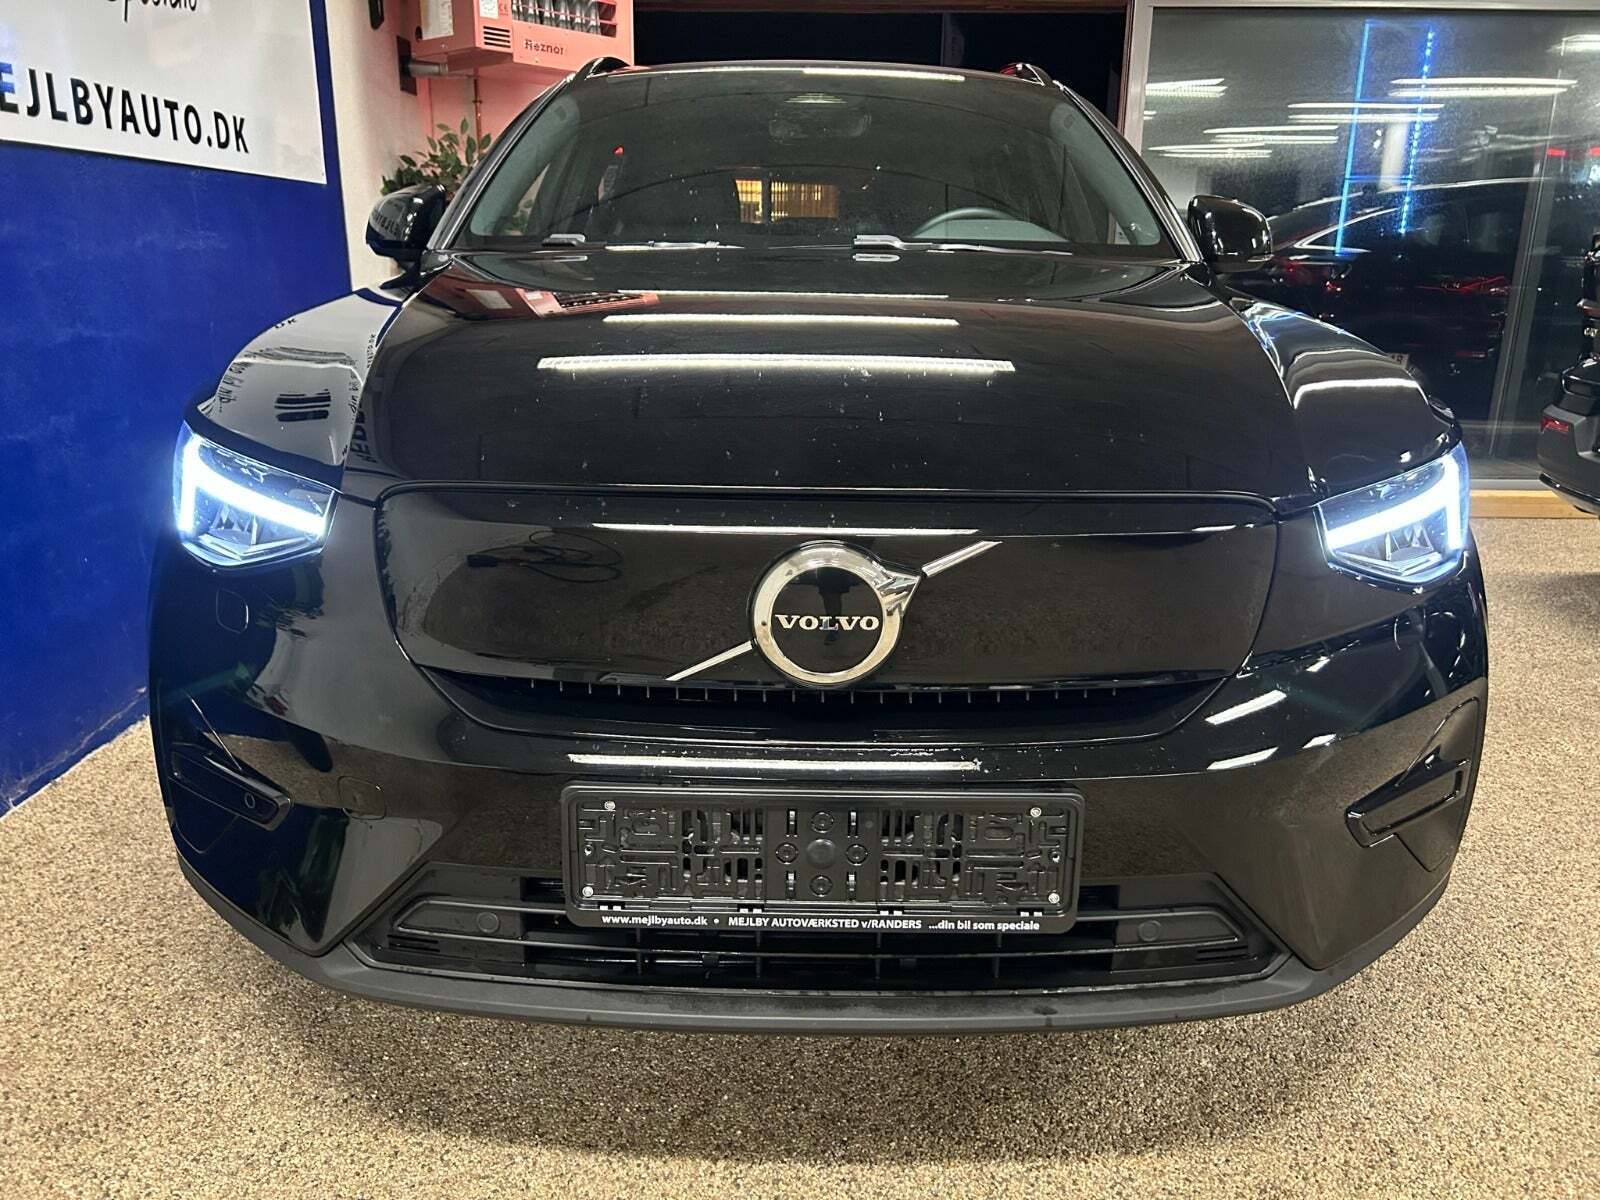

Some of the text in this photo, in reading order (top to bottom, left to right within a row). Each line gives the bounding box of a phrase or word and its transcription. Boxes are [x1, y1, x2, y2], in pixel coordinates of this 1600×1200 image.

[775, 614, 880, 631] VOLVO
[602, 915, 708, 927] www.mejlbyauto.dk
[728, 917, 1040, 933] MEJLBY AUTOVÆRKSTED v/RANDERS ...din bil som speciale
